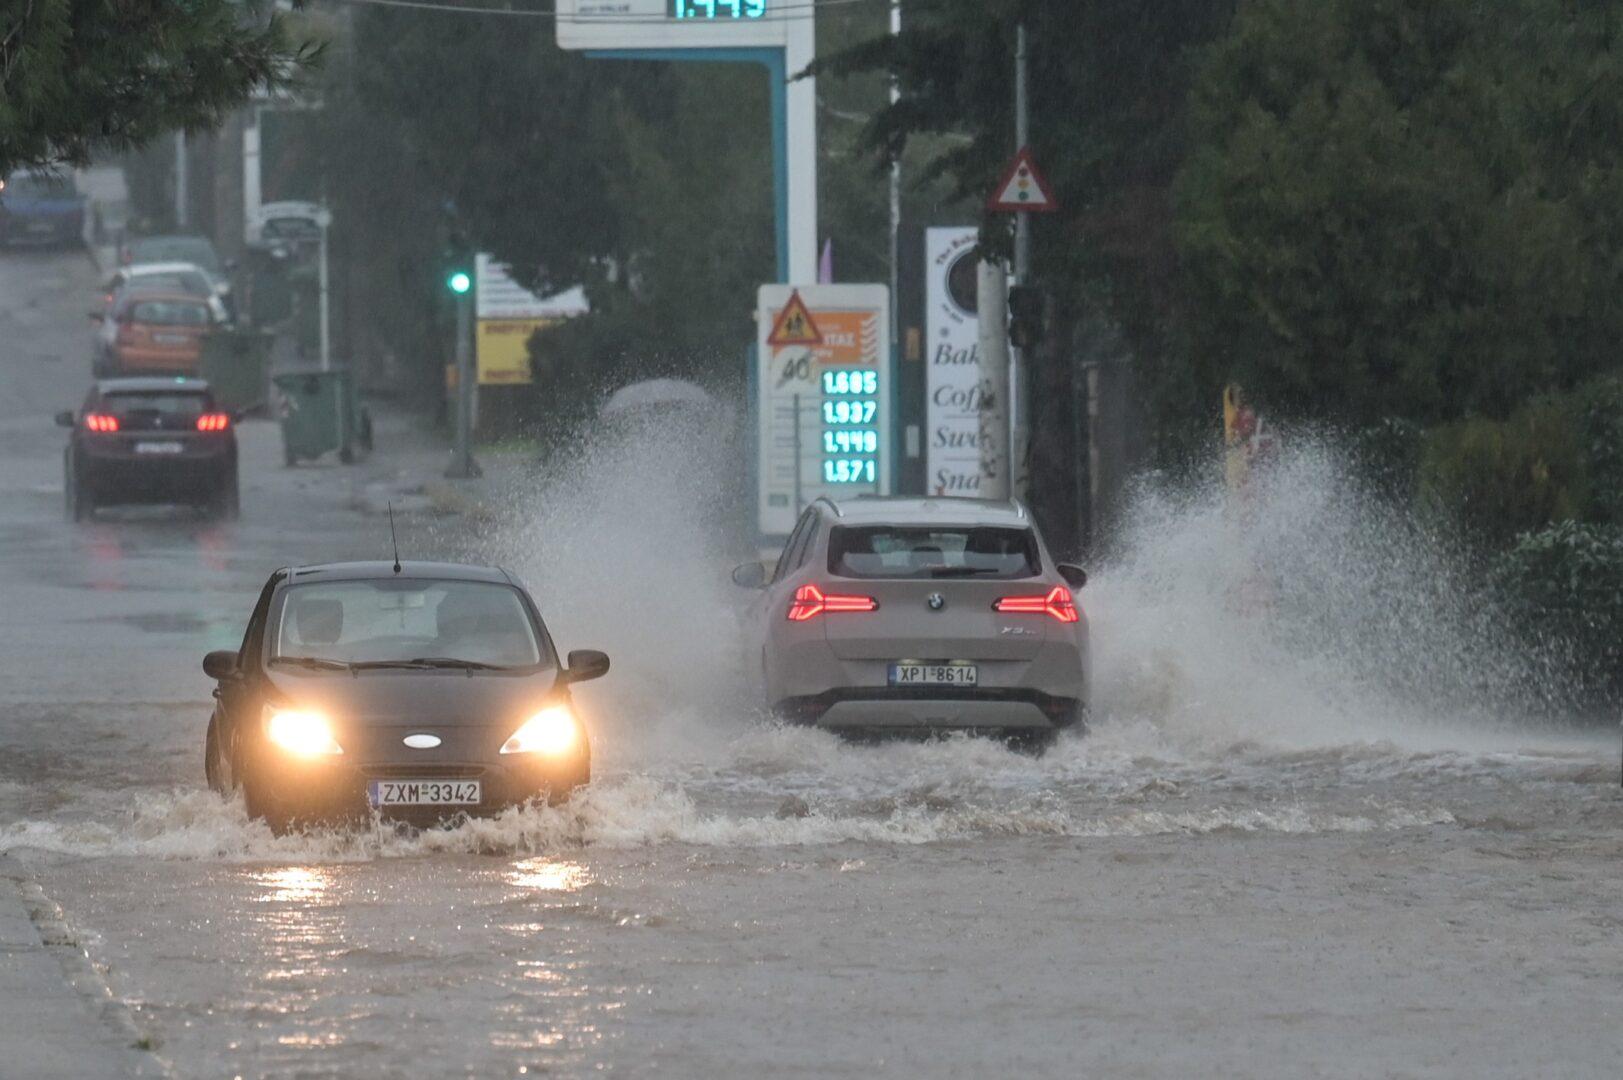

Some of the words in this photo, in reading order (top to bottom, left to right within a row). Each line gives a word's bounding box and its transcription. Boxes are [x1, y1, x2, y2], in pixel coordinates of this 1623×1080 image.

[934, 343, 980, 366] Bak
[824, 459, 875, 482] 1.571
[935, 468, 980, 491] Sna
[383, 783, 478, 803] ZXM-3342
